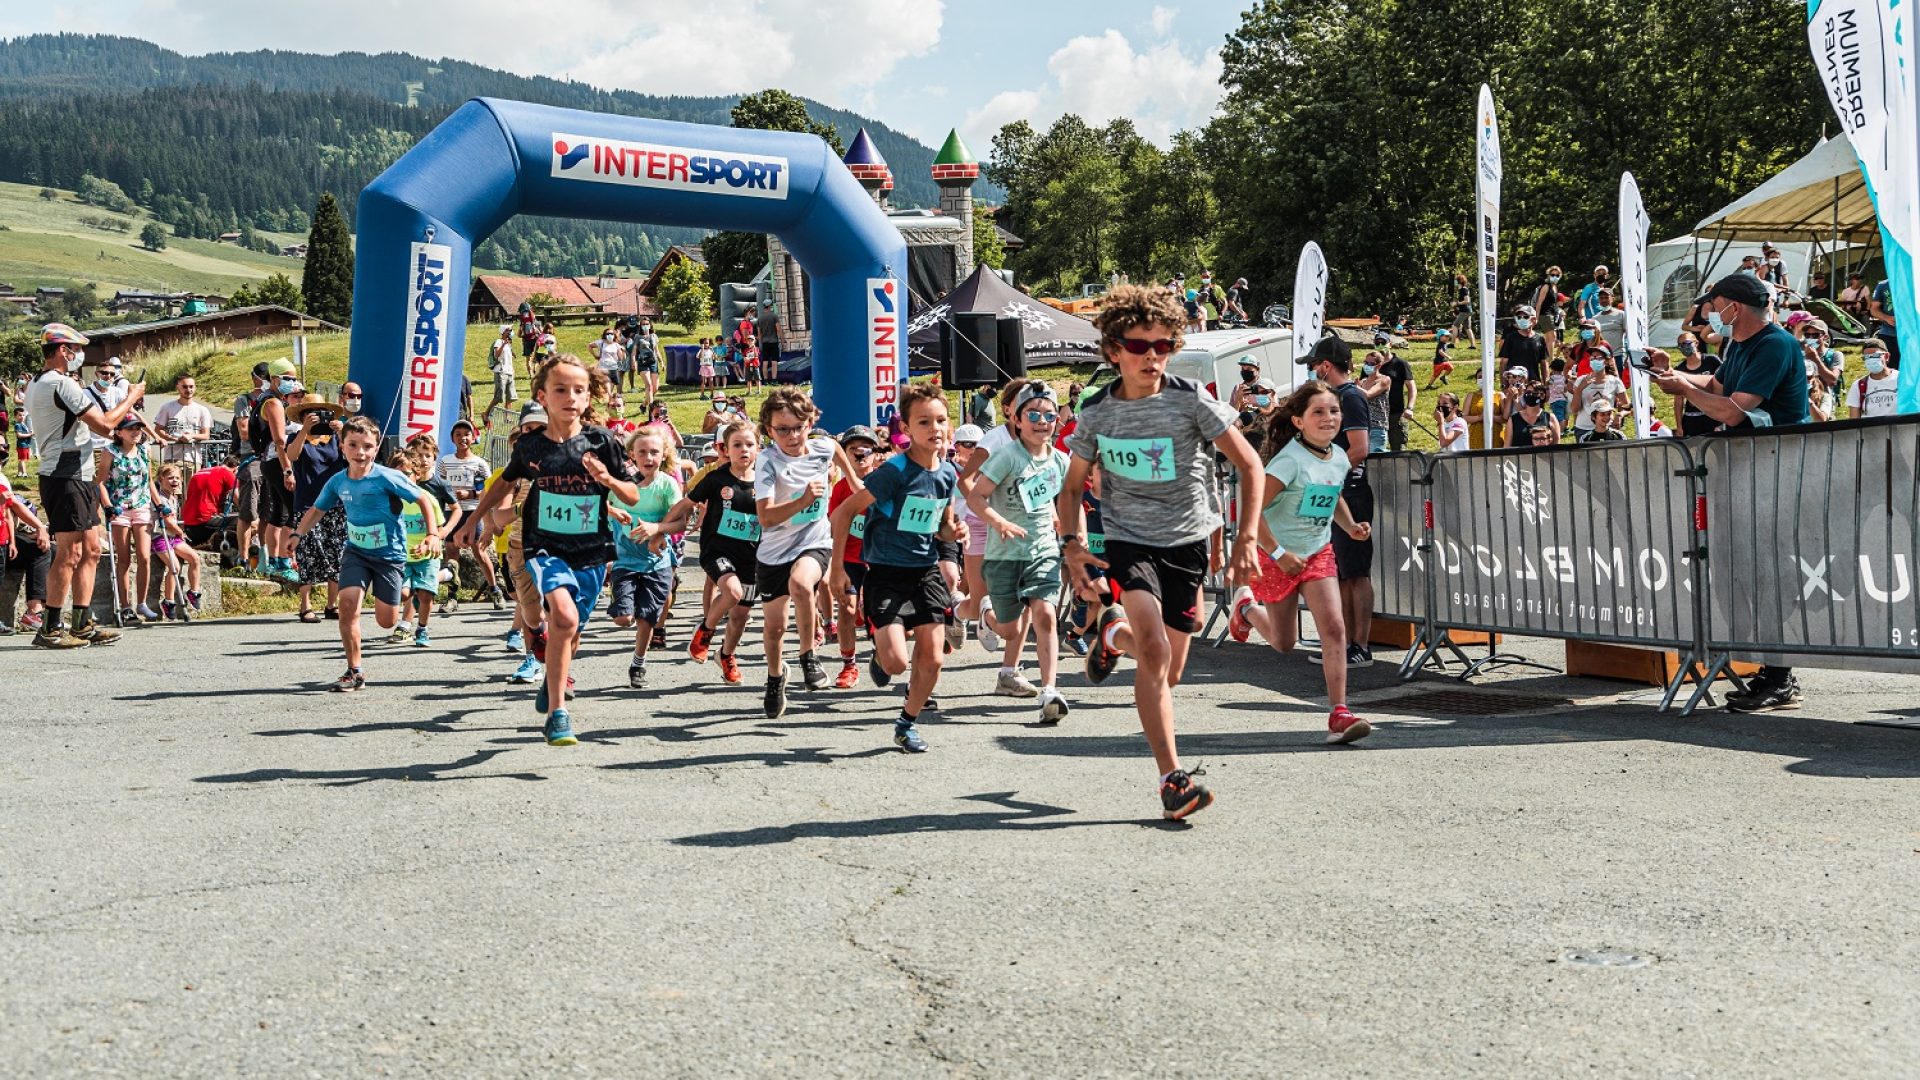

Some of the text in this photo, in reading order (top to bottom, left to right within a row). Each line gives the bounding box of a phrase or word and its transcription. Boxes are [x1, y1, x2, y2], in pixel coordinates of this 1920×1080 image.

[594, 144, 782, 190] INTERSPORT
[406, 253, 444, 442] NTERSPORT
[1107, 448, 1137, 467] 119
[1027, 483, 1047, 501] 145
[1310, 494, 1334, 508] 122
[546, 504, 572, 522] 141
[909, 507, 933, 523] 117
[726, 517, 746, 532] 136
